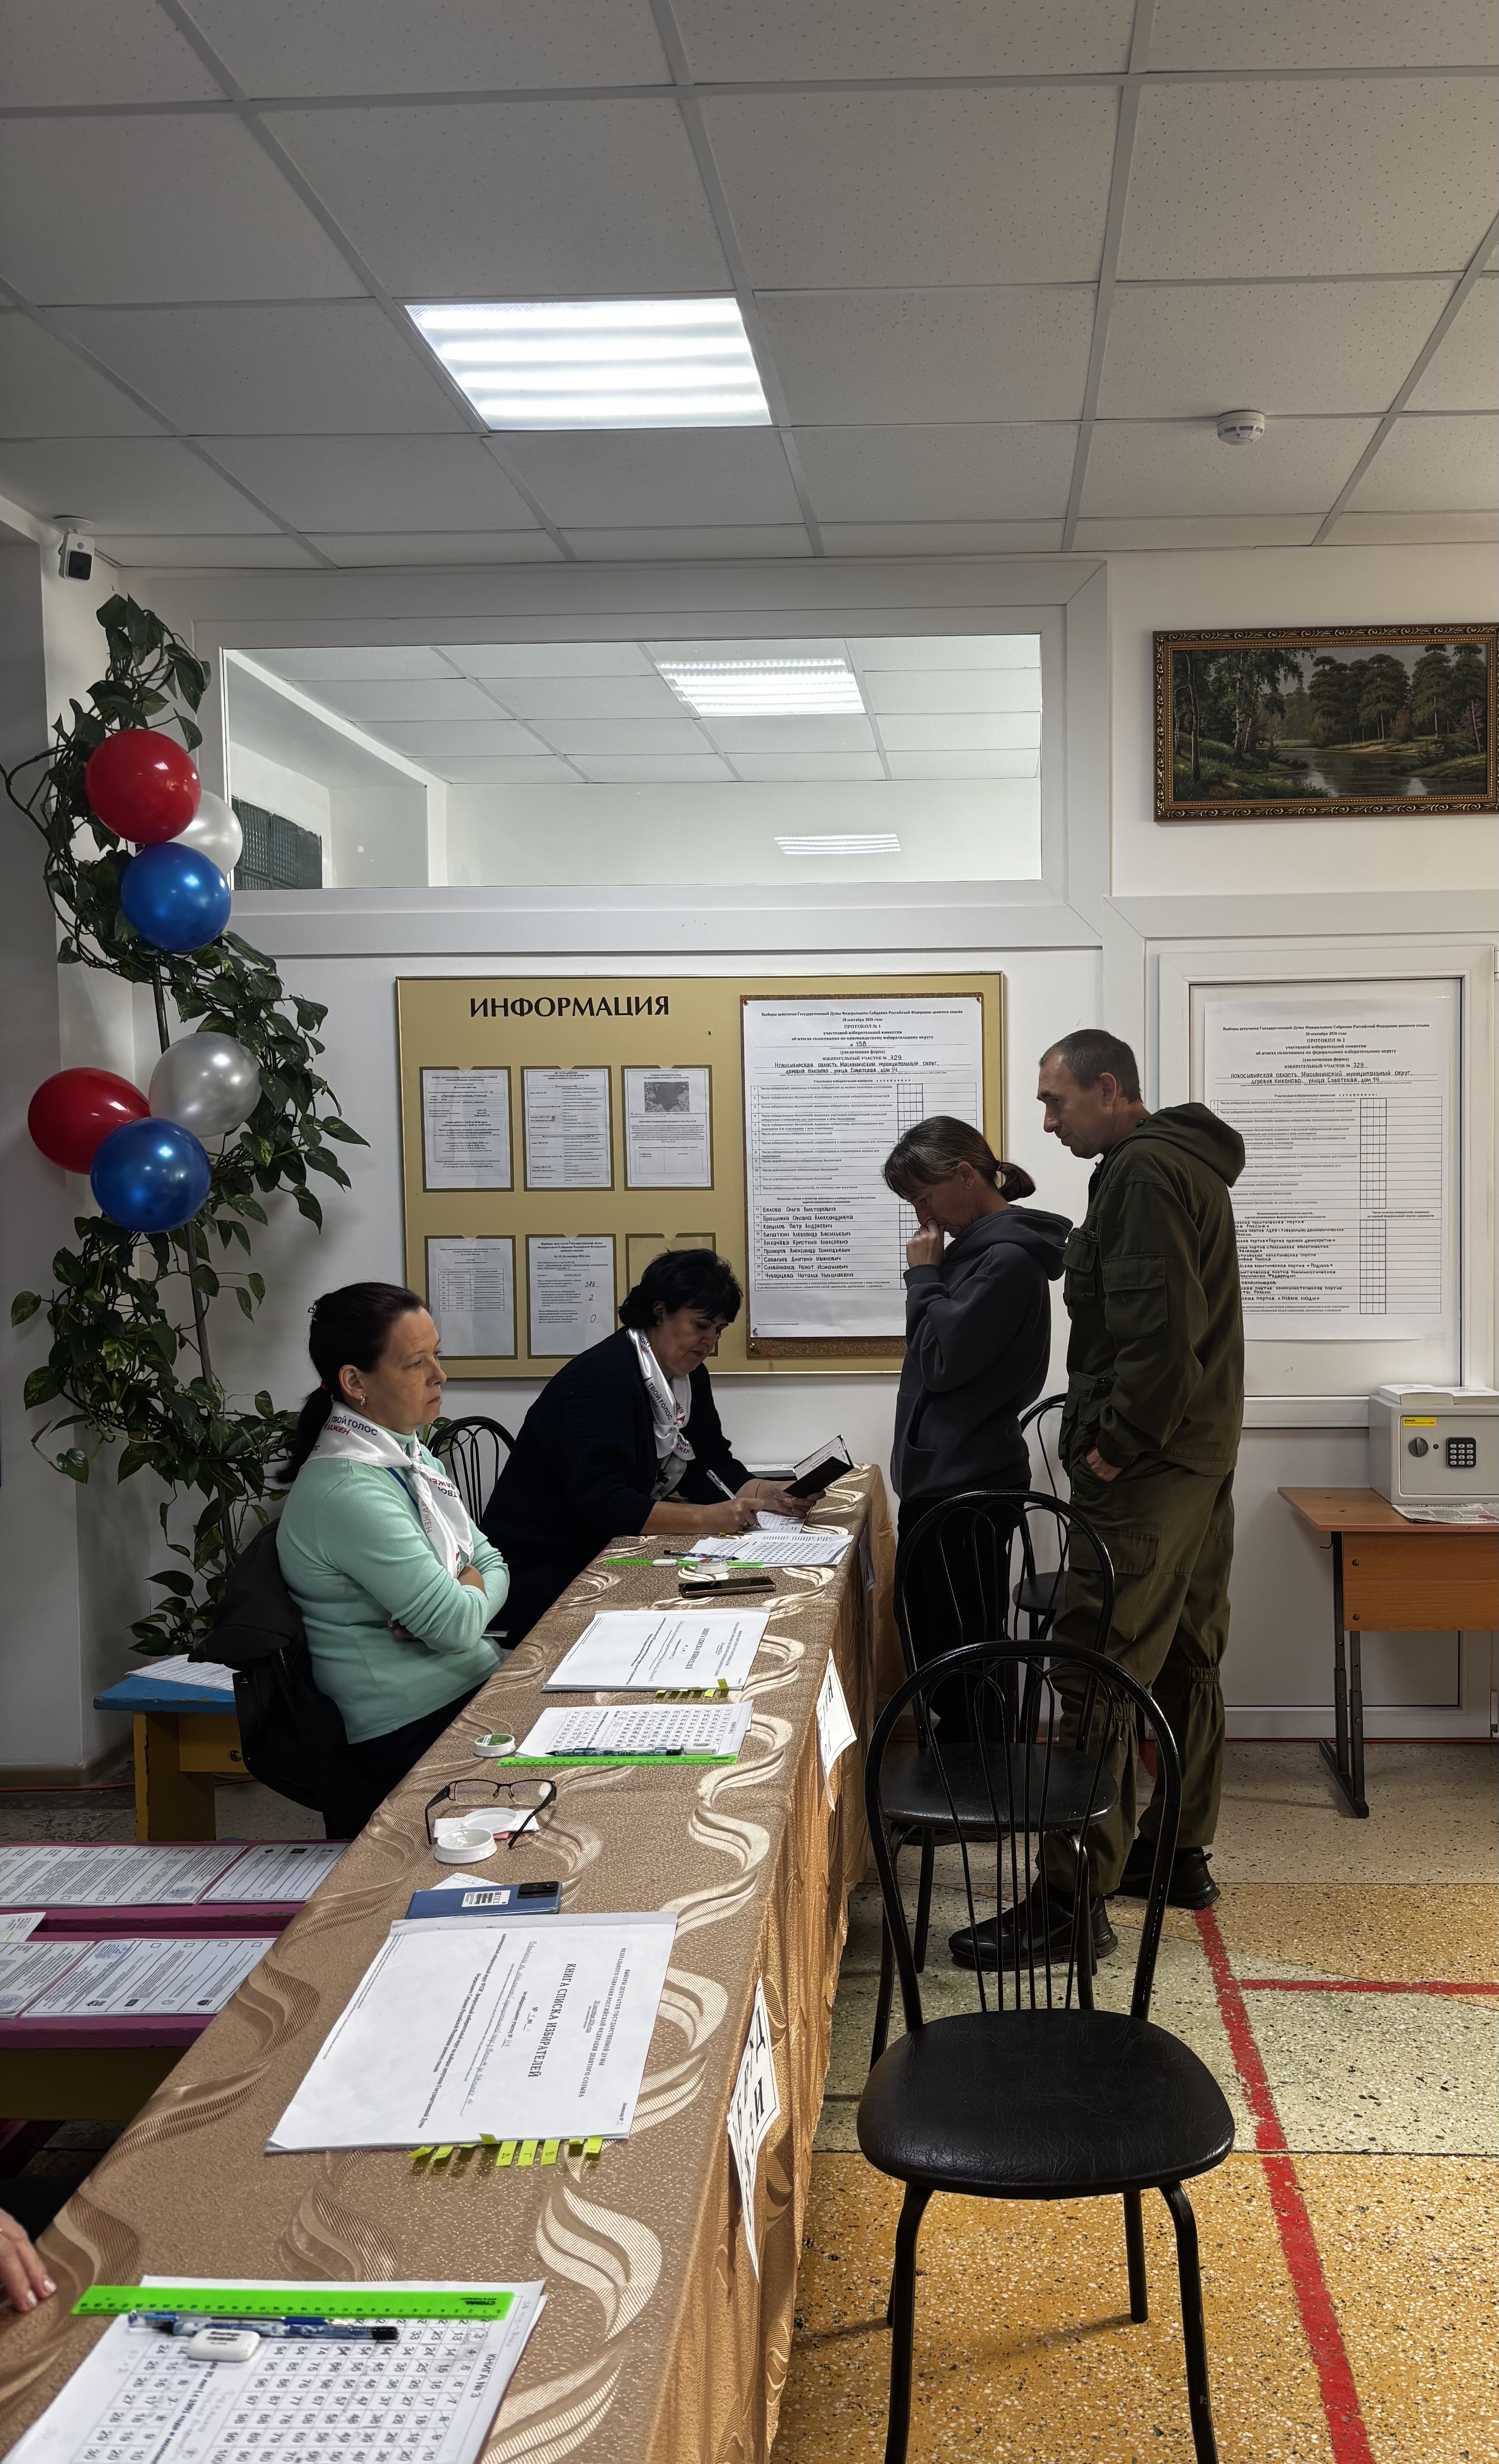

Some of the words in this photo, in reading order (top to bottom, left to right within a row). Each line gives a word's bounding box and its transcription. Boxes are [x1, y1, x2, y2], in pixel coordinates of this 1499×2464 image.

[471, 996, 669, 1017] ИНФОРМАЦИЯ
[648, 1382, 661, 1401] ТВОЙ
[659, 1399, 673, 1420] ГОЛОС
[332, 1415, 346, 1425] ТВОЙ
[348, 1419, 378, 1436] ГОЛОС
[558, 1963, 577, 1987] КНИГА
[547, 1989, 568, 2020] СПИСКА
[527, 2022, 558, 2077] ИЗБИРАТЕЛЕЙ
[577, 2077, 590, 2097] СОЗЫВА
[478, 2353, 497, 2380] КНИГА
